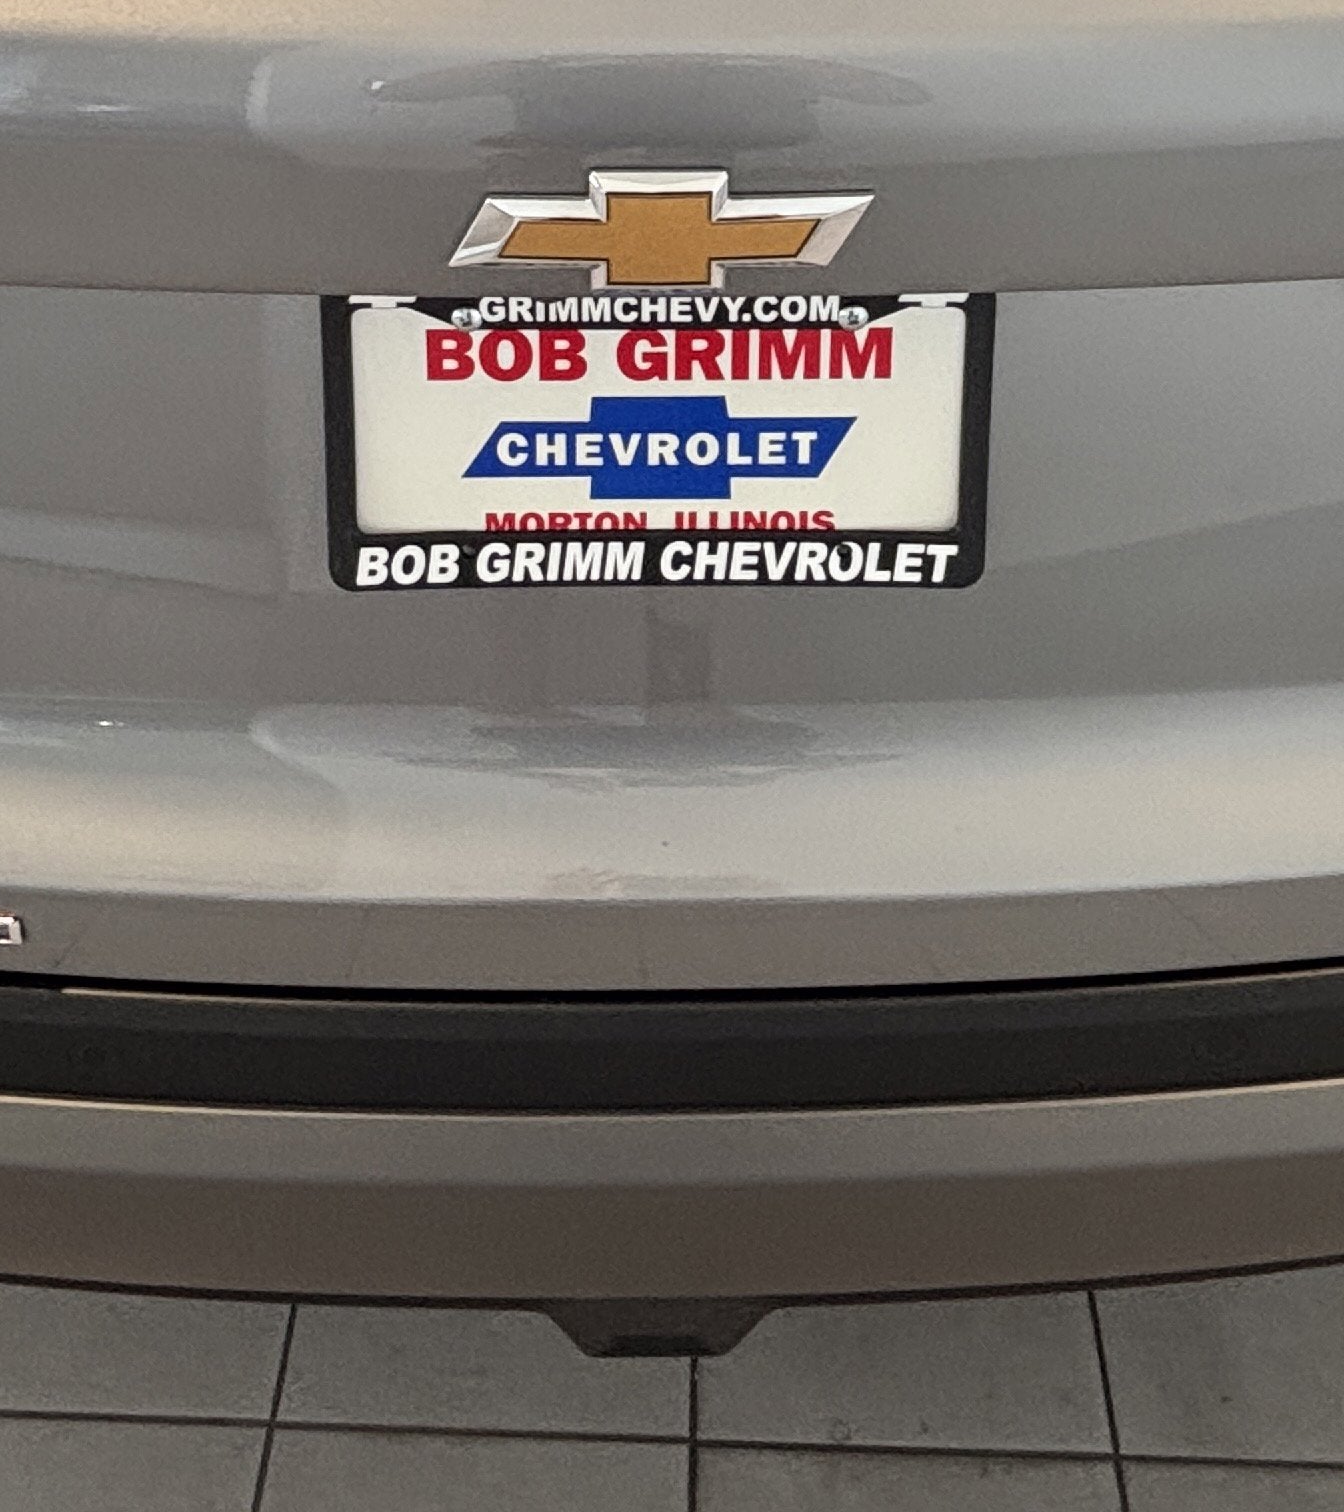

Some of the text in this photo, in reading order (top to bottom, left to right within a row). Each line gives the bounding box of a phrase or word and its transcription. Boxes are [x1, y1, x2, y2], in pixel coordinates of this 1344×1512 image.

[478, 295, 841, 324] GRIMMCHEVY.COM
[425, 326, 893, 382] BOB GRIMM
[496, 431, 818, 467] CHEVROLET
[356, 541, 960, 586] BOB GRIMM CHEVROLET
